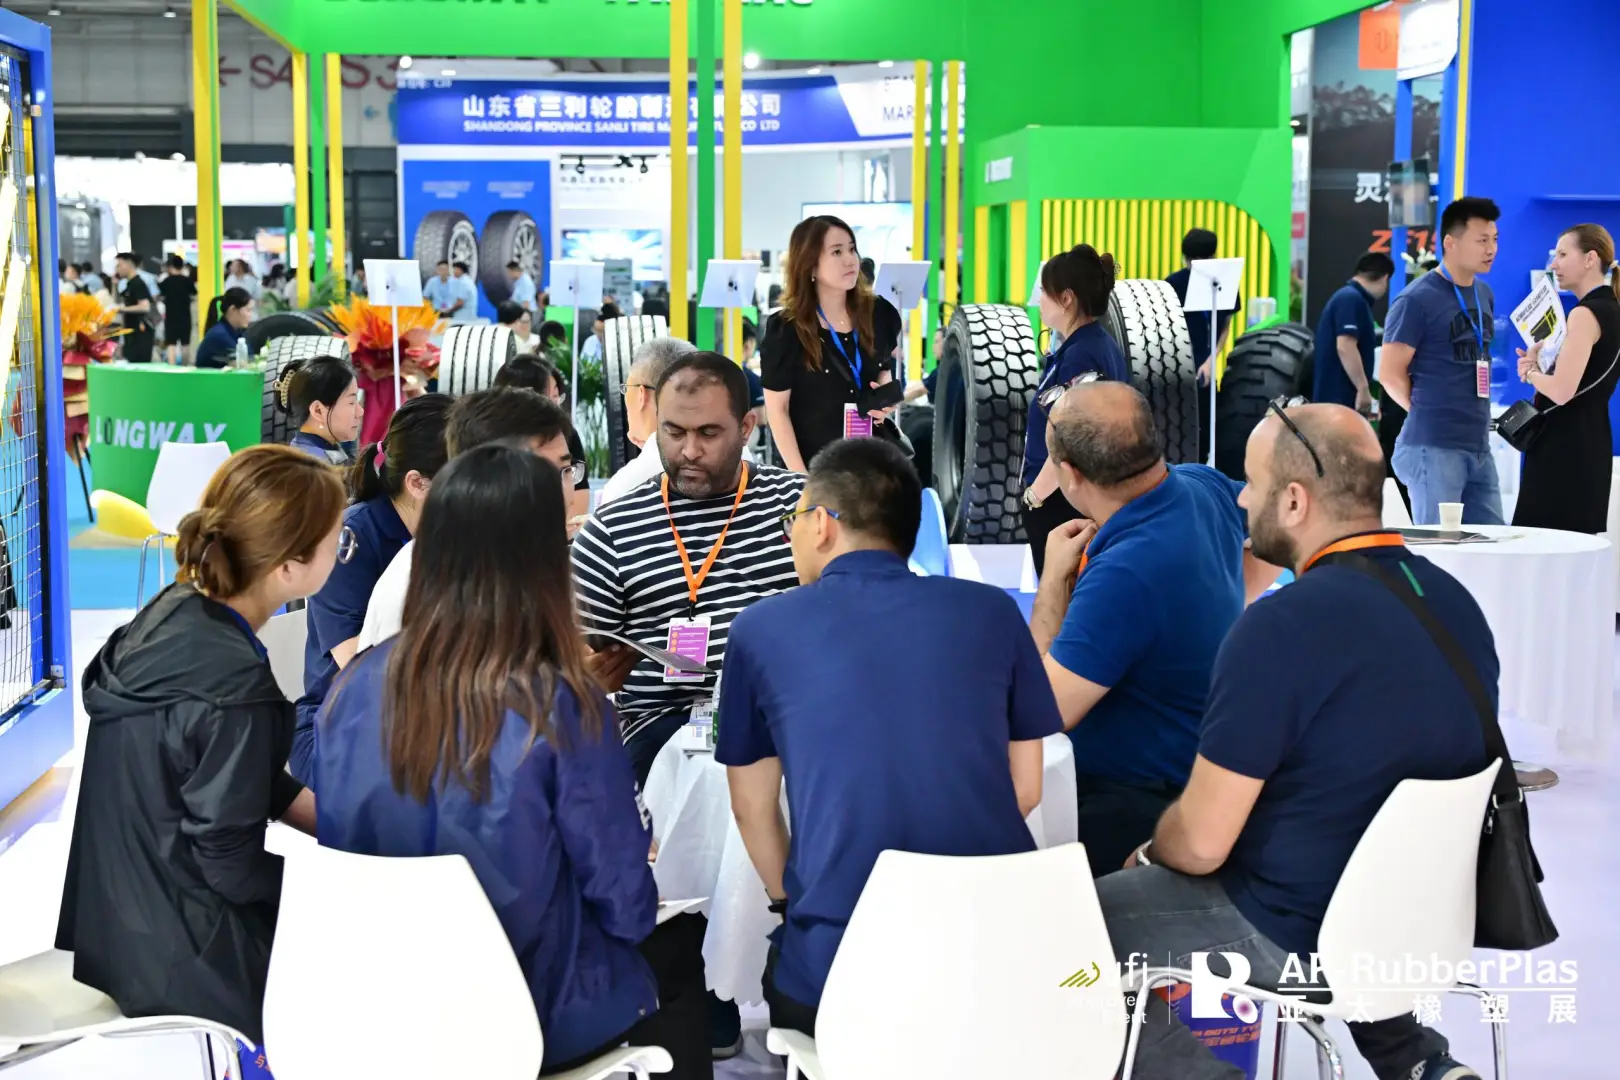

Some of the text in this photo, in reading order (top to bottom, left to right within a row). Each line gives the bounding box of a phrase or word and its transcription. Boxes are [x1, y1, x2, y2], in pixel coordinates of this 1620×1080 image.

[463, 94, 781, 119] 山东省三利轮胎制公司
[463, 119, 533, 133] SHANDONG
[534, 120, 593, 133] PROVINCE
[594, 121, 629, 134] SANLI
[631, 121, 656, 134] TIRE
[760, 119, 781, 132] LTD
[95, 416, 227, 450] LONGWAY
